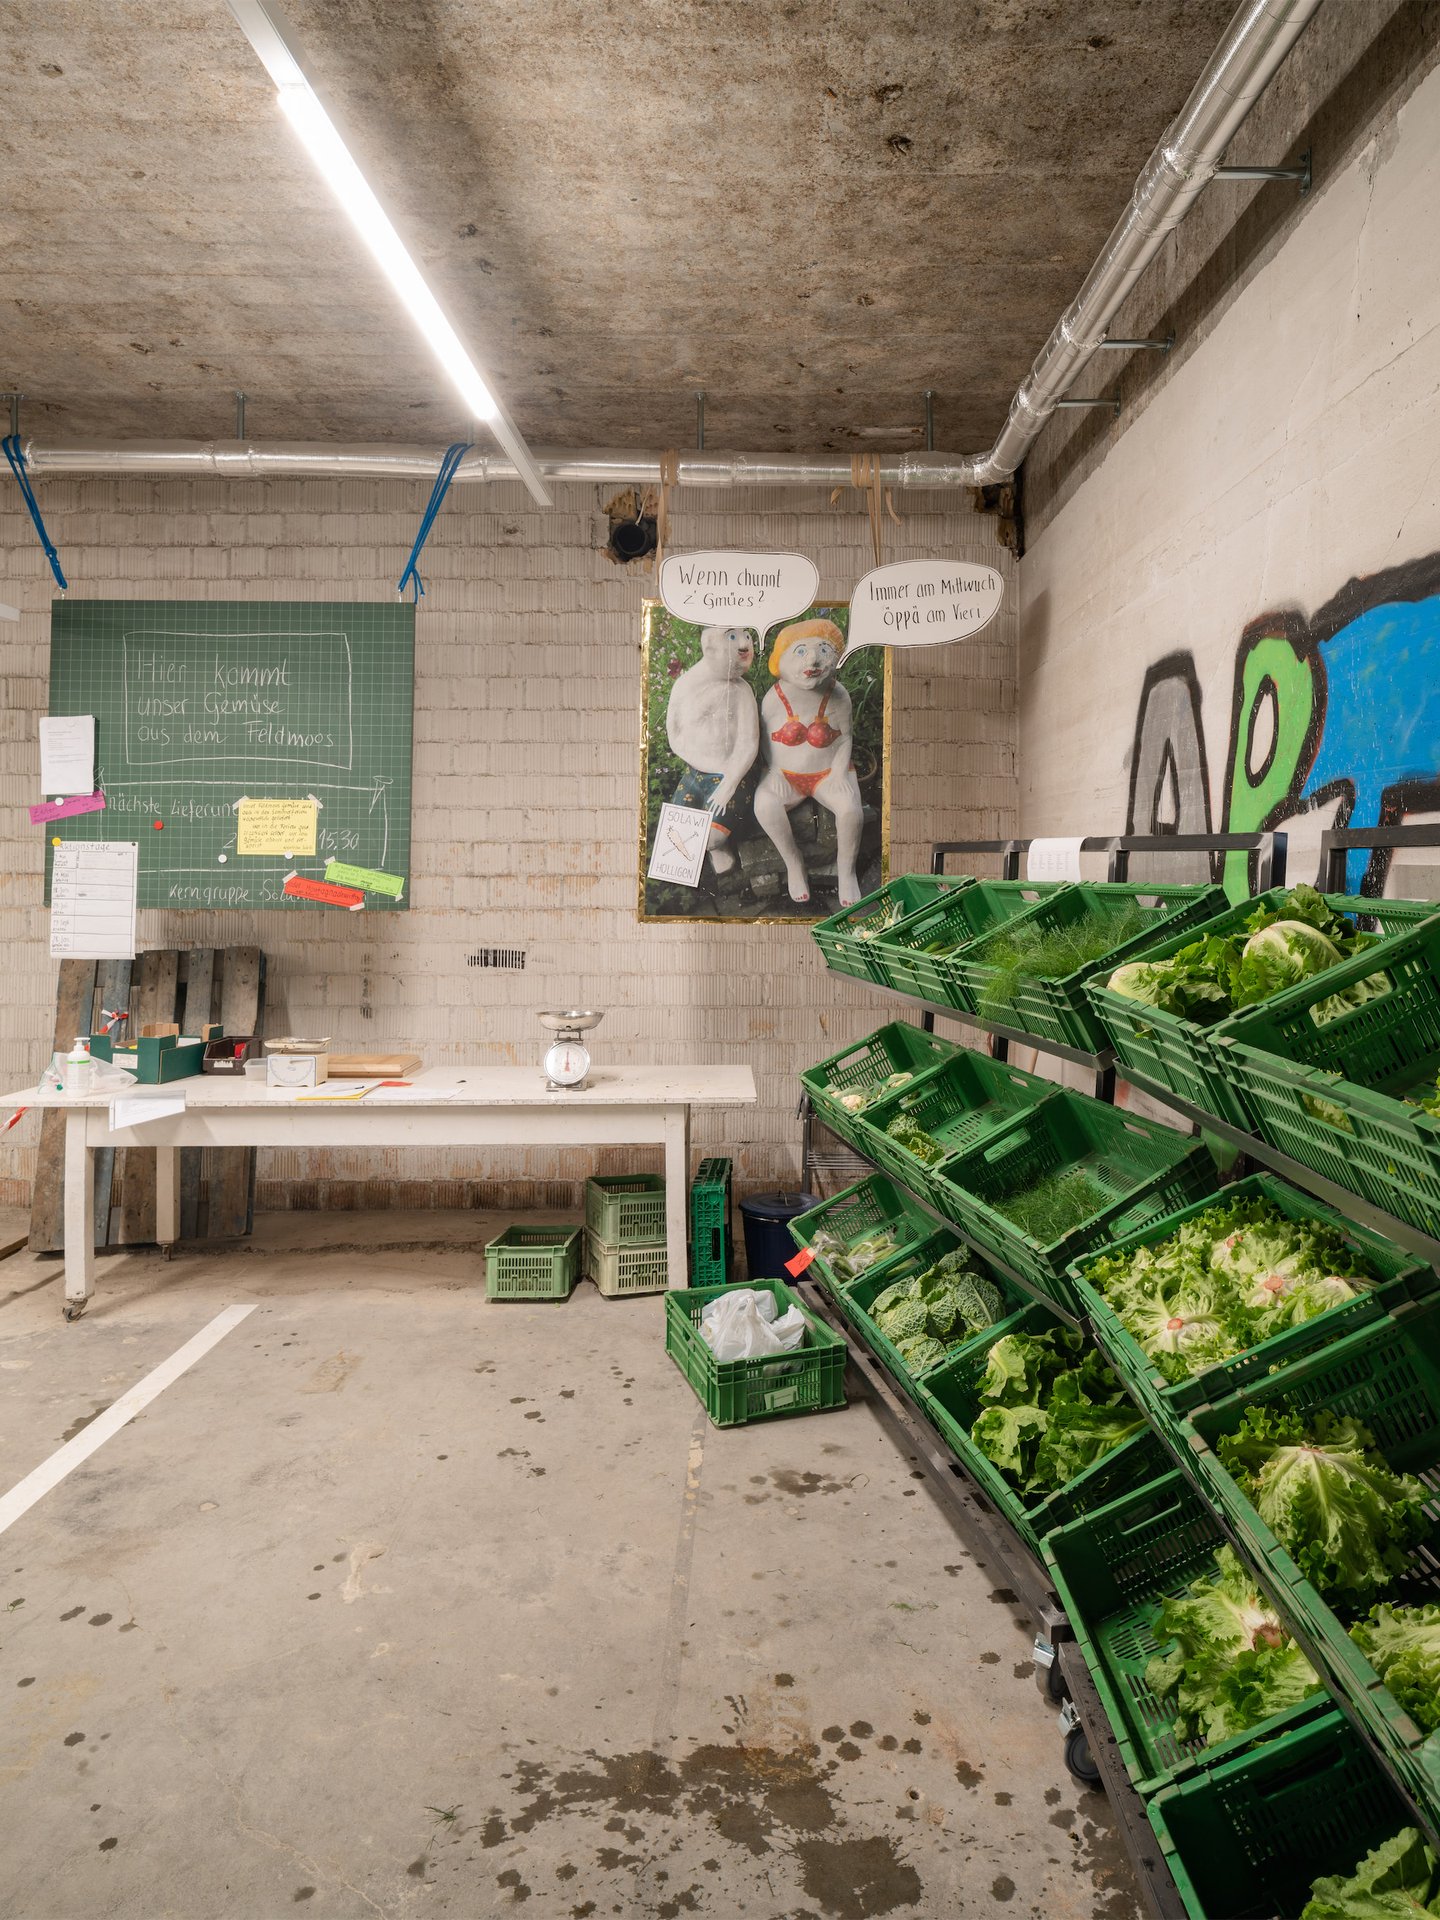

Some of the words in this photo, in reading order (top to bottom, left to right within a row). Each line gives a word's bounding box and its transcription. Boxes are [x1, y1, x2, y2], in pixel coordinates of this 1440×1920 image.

[679, 563, 728, 586] Wenn
[737, 567, 783, 588] chunnt
[869, 581, 911, 601] Immer
[916, 583, 935, 598] am
[926, 609, 946, 624] am
[137, 650, 187, 684] Hier
[204, 692, 286, 725] Gemüse
[137, 725, 170, 746] aus
[184, 723, 229, 744] dem
[242, 720, 334, 748] Feldmoos
[667, 811, 705, 828] SOLAWI
[169, 883, 254, 907] Kerngruppe
